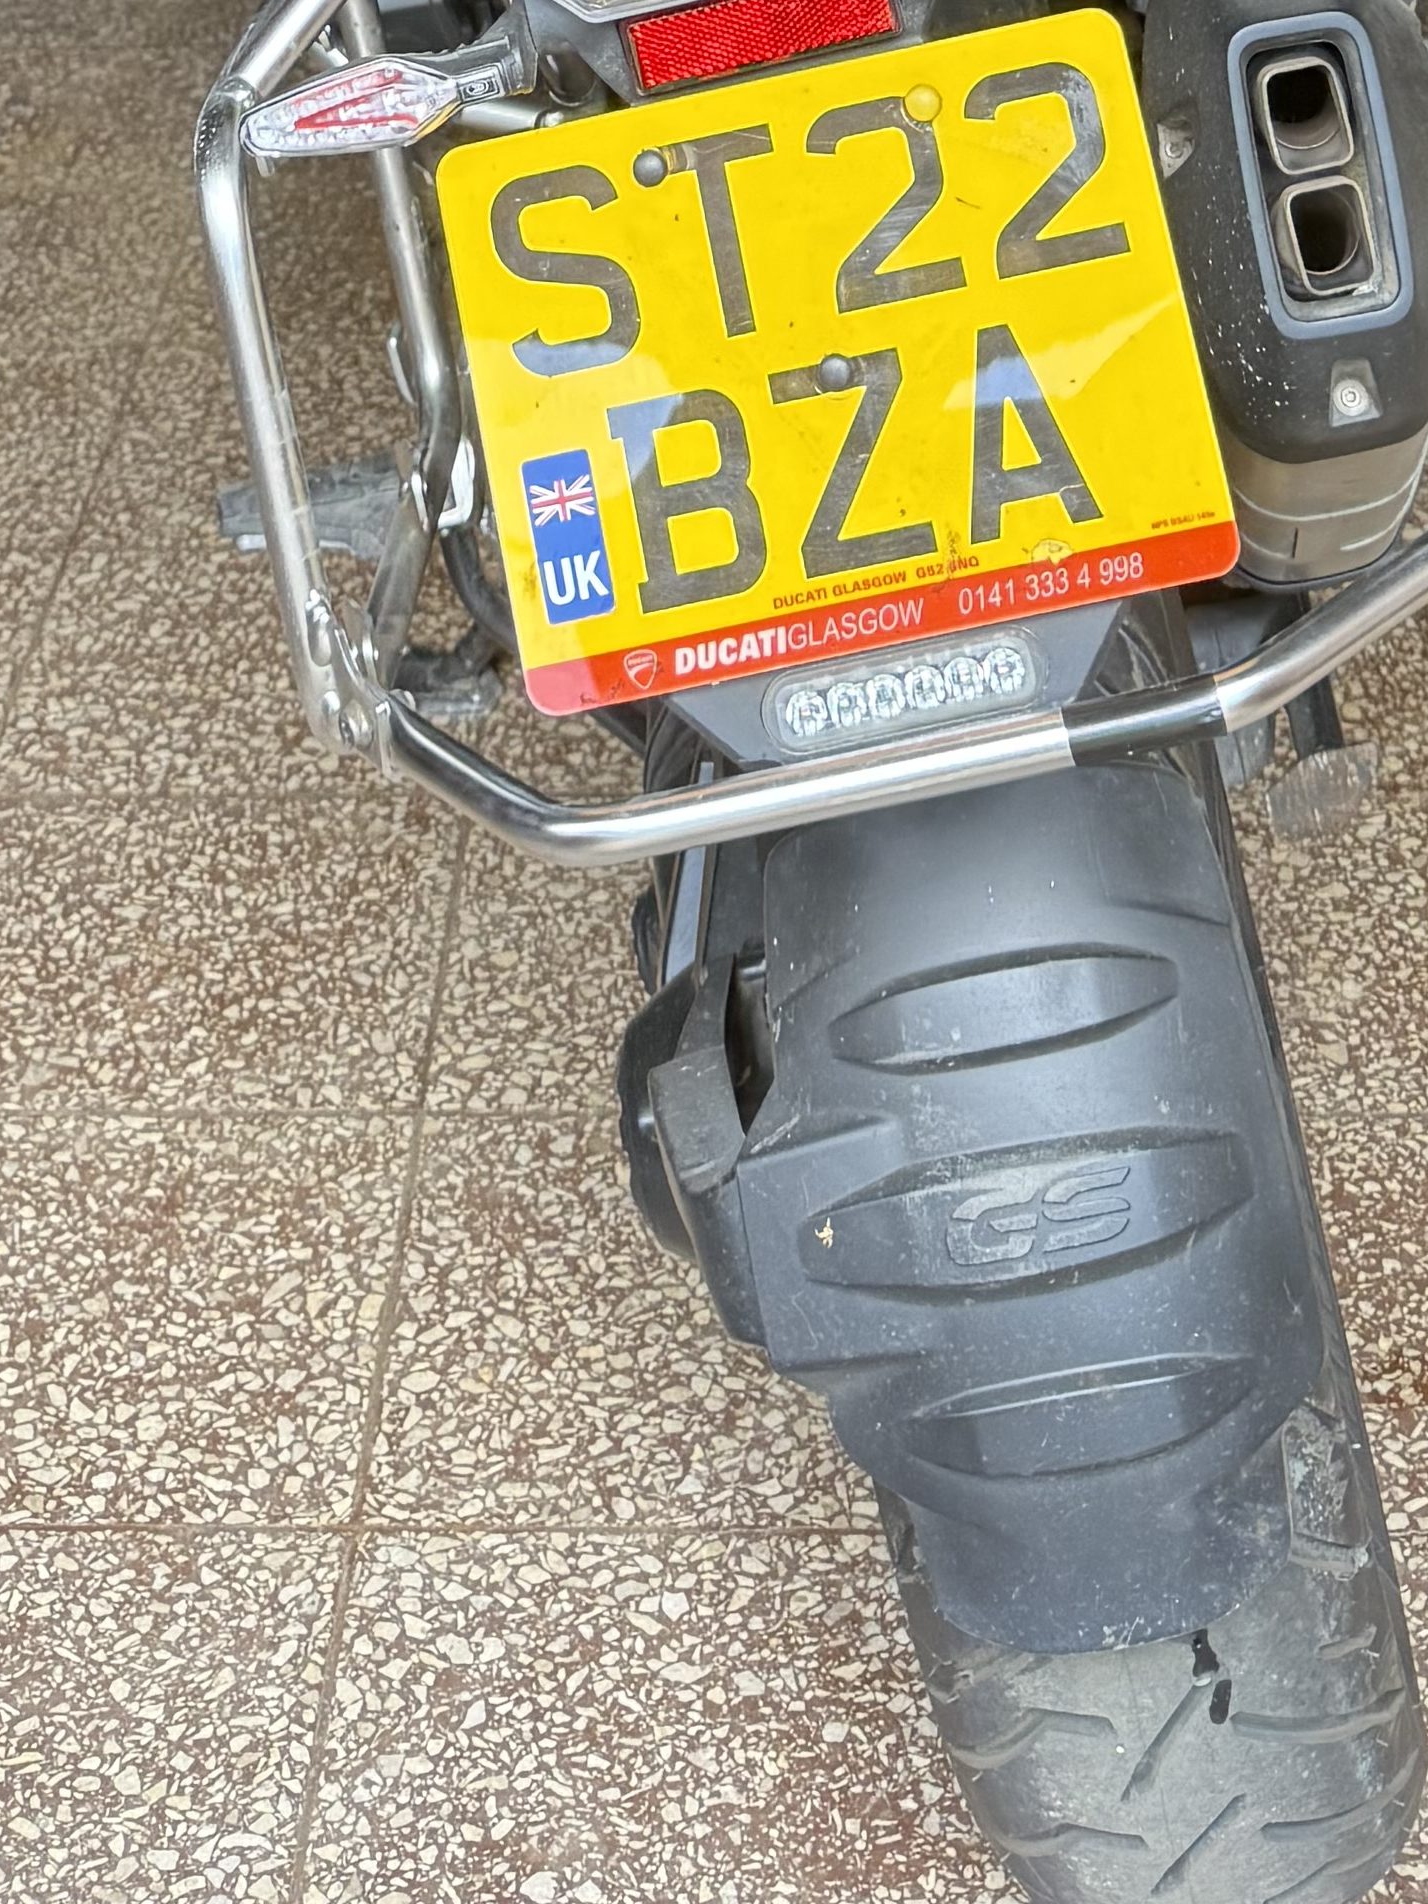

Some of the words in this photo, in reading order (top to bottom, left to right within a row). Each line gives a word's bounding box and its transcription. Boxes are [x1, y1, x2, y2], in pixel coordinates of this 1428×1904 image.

[489, 61, 1133, 379] ST22
[606, 323, 1105, 614] BZA
[542, 549, 610, 608] UK
[773, 587, 828, 610] DUCATI
[832, 571, 908, 598] GLASGOW
[958, 580, 1016, 616] 0141
[1025, 567, 1069, 601] 333
[1076, 562, 1092, 588] 4
[1099, 552, 1144, 586] 998
[945, 1165, 1132, 1267] GS
